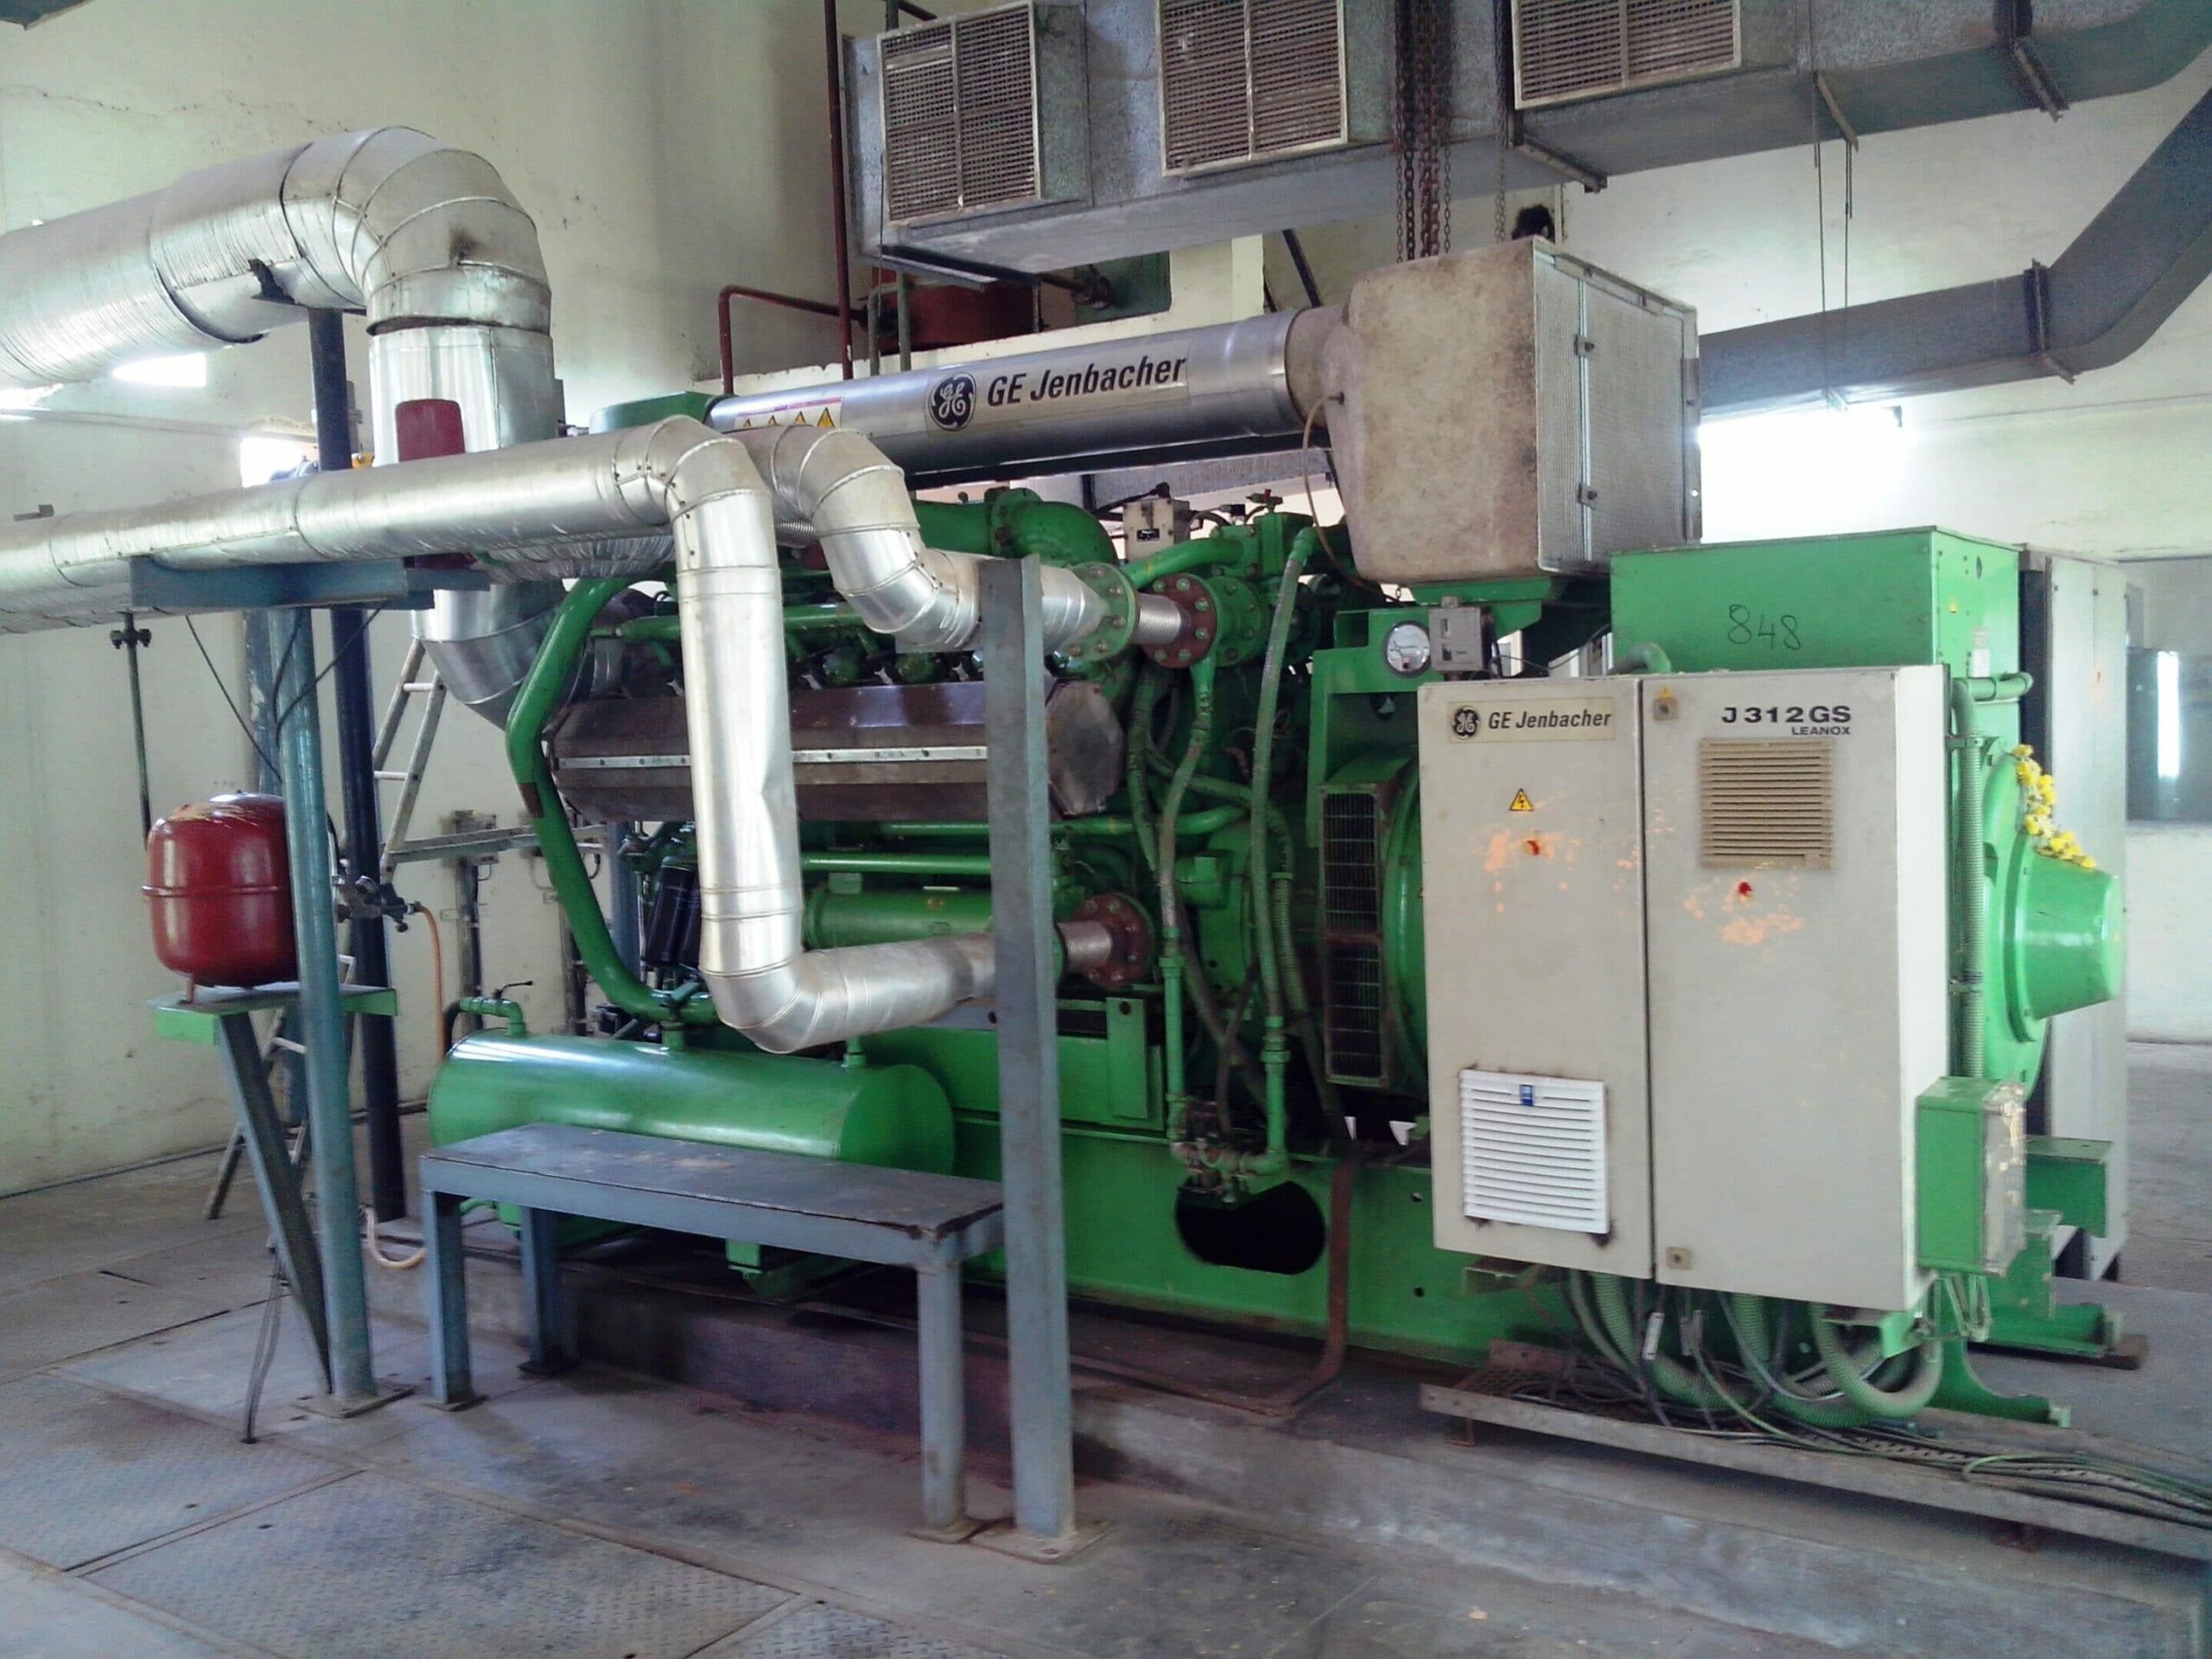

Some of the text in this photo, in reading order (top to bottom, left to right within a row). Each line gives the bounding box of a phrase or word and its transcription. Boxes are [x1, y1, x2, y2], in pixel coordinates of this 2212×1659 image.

[988, 355, 1186, 407] GE Jenbacher
[1728, 604, 1802, 650] 848
[1488, 709, 1612, 729] GE Jenbacher
[1791, 726, 1852, 735] LEANOX
